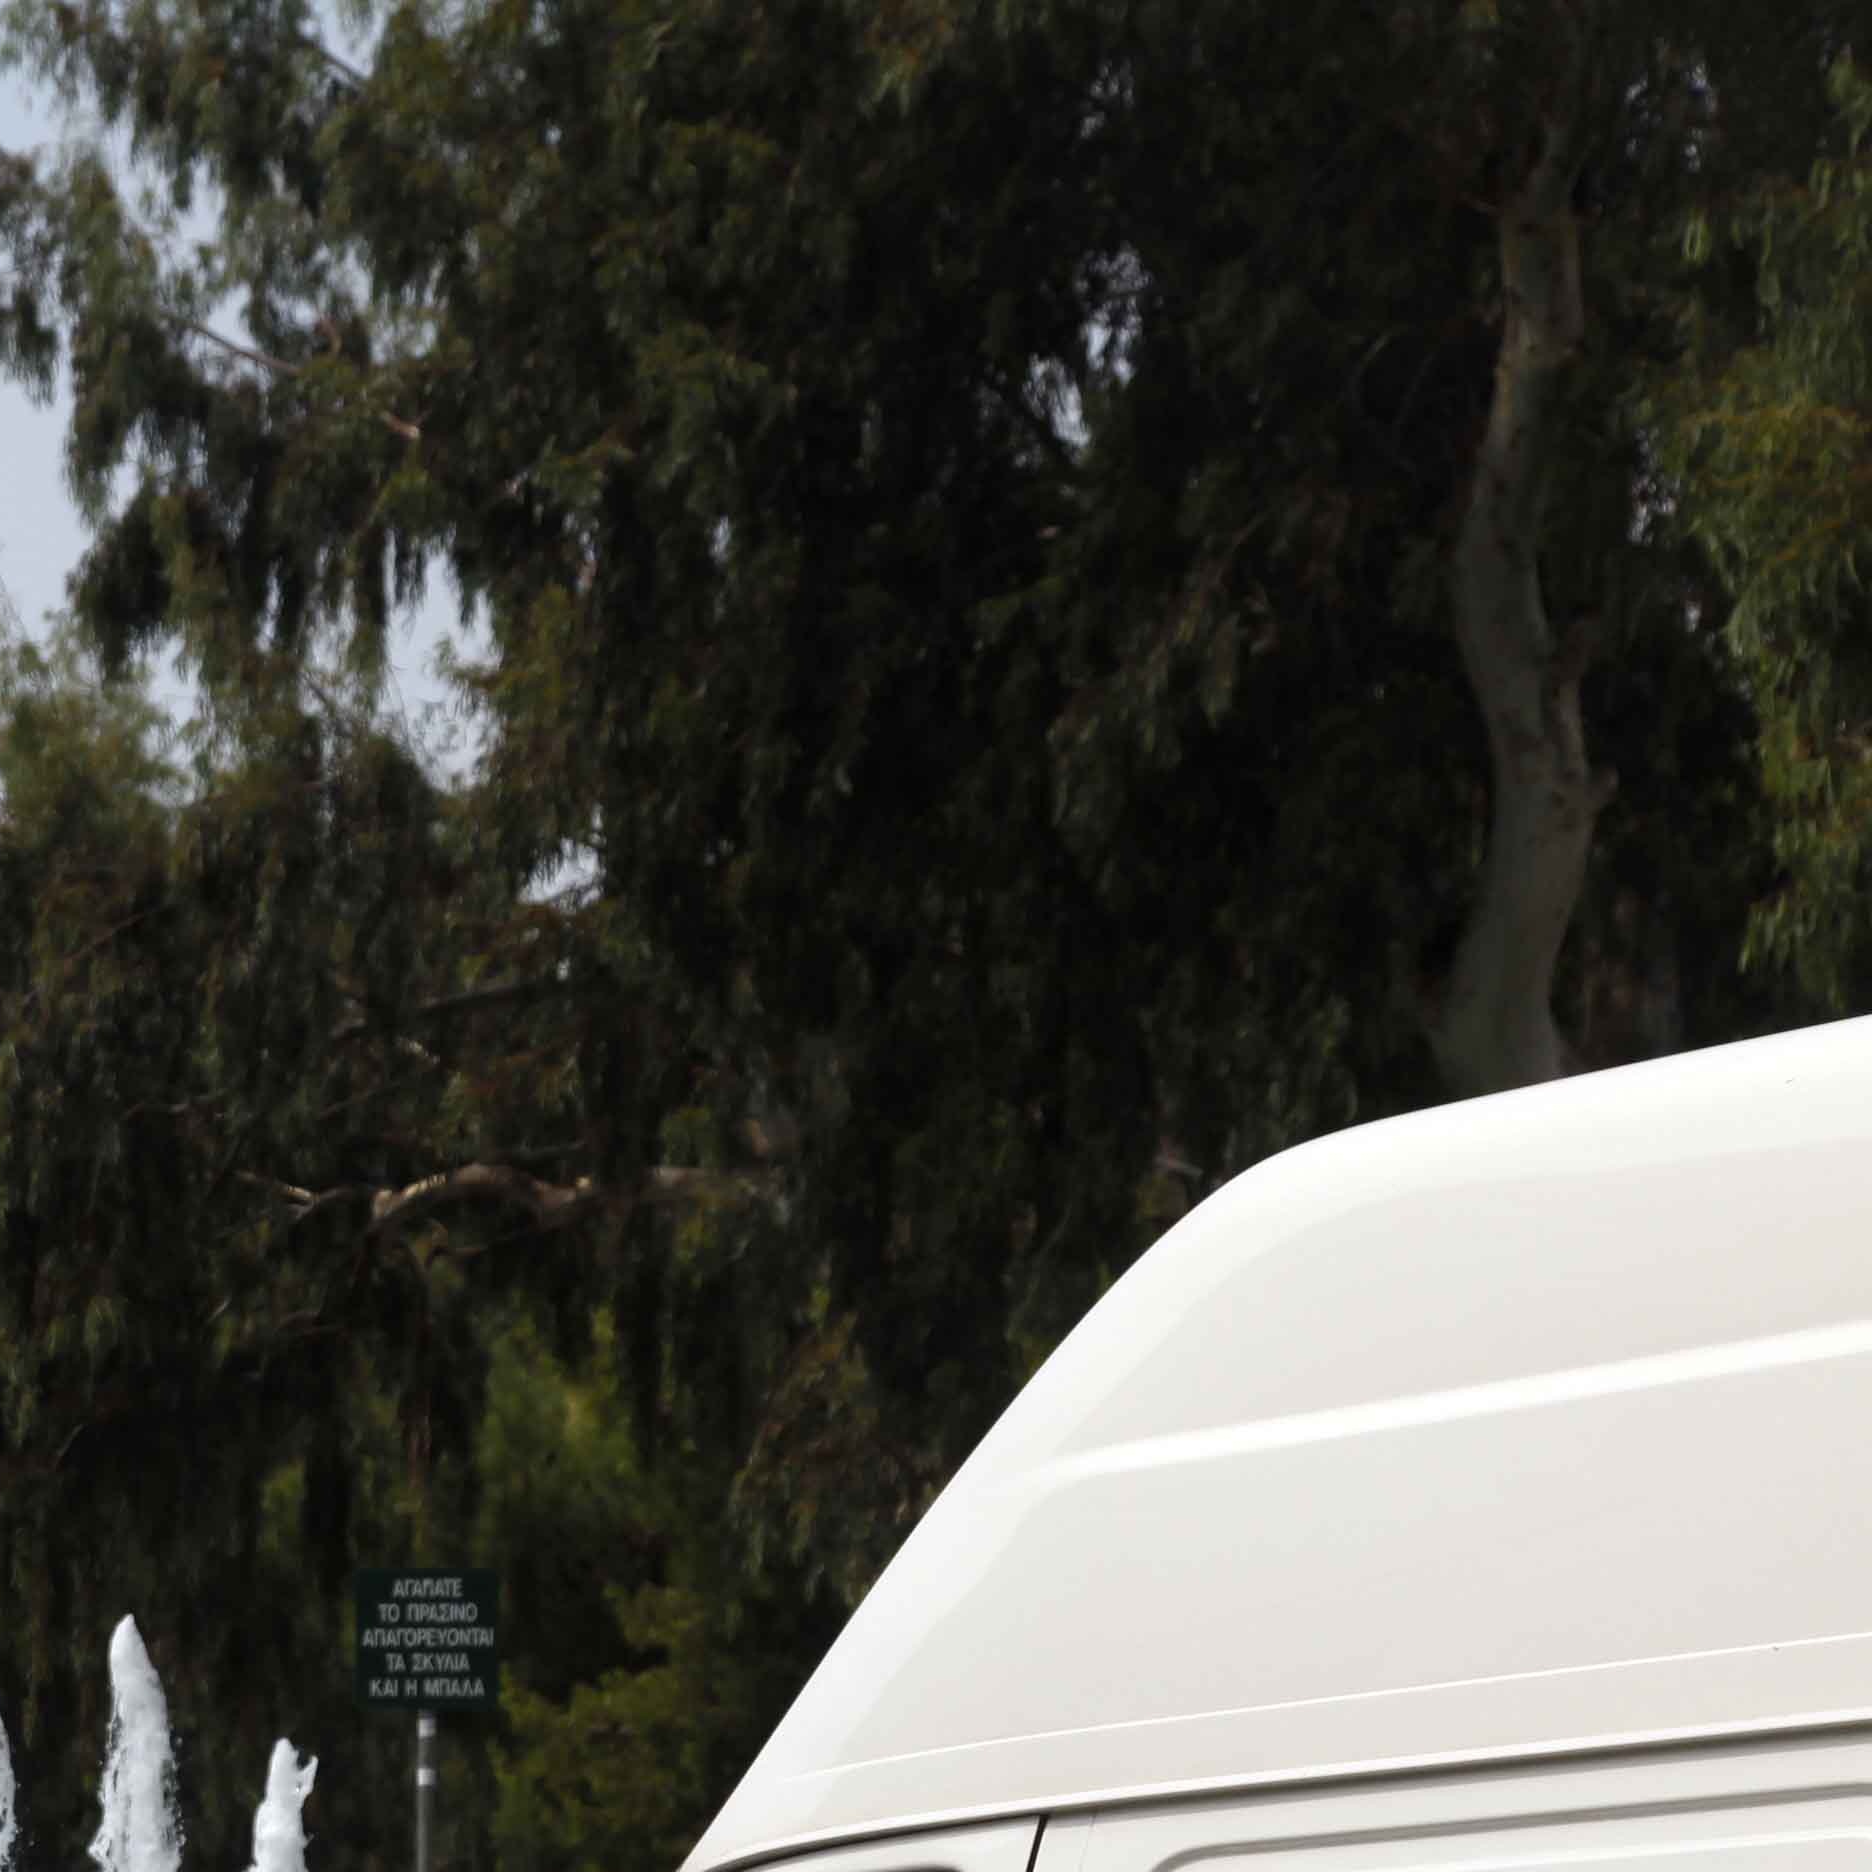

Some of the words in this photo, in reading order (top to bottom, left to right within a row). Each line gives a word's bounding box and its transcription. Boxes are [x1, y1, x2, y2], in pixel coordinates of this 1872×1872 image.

[392, 1577, 464, 1598] ΑΓΑΠΑΤΕ
[378, 1603, 400, 1622] ΤΟ
[407, 1603, 478, 1622] ΠΡΑΣΙΝΟ
[362, 1627, 494, 1648] ΑΠΑΓΟΡΕΥΟΝΤΑΙ
[386, 1653, 405, 1672] ΤΑ
[412, 1653, 470, 1672] ΣΚΥΛΙΑ
[369, 1678, 398, 1697] ΚΑΙ
[405, 1678, 418, 1697] Η
[423, 1678, 485, 1697] ΜΠΑΛΑ
